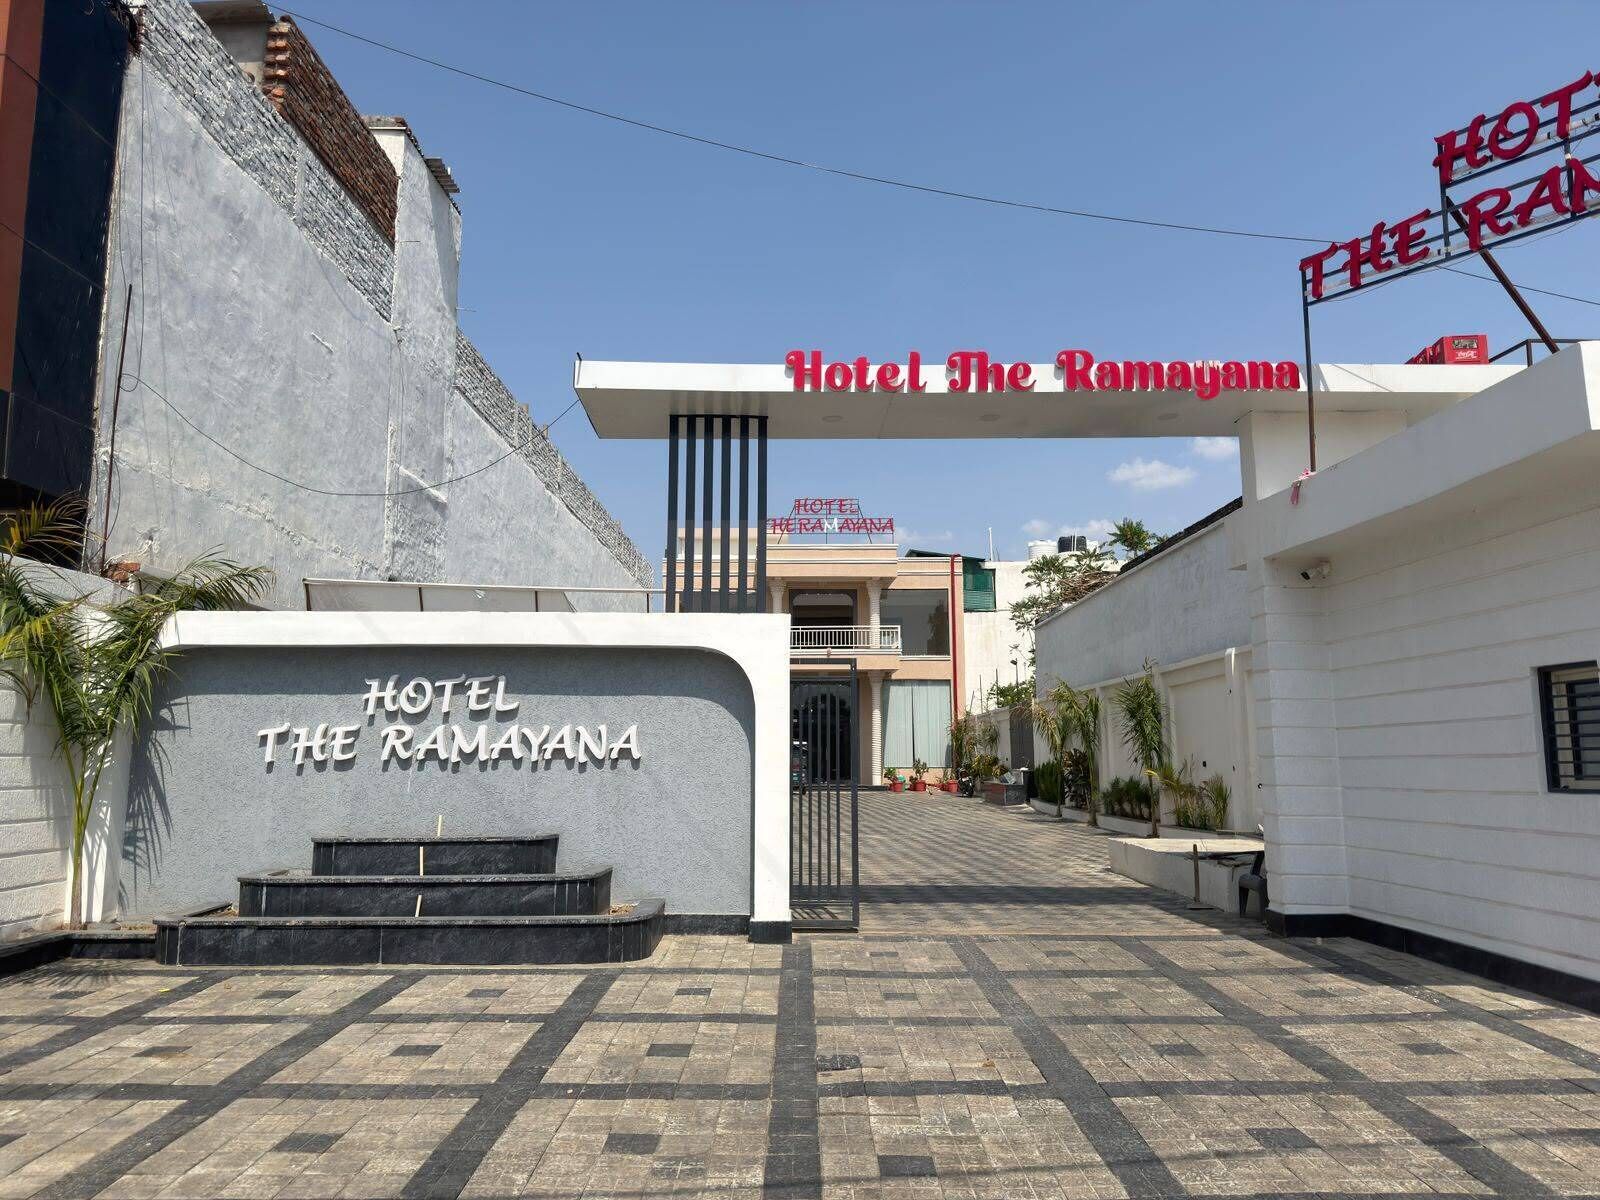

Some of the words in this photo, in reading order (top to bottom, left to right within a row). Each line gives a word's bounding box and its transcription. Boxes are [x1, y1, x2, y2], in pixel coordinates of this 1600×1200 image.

[1432, 70, 1600, 185] HOT
[1299, 208, 1431, 299] THE
[785, 350, 927, 391] Hotel
[947, 351, 1036, 391] The
[1056, 350, 1300, 400] Ramayana
[766, 517, 795, 534] HE
[799, 517, 894, 534] RAMAYANA
[795, 498, 859, 514] HOTEL
[363, 674, 519, 715] HOTEL
[257, 722, 357, 765] THE
[380, 724, 642, 763] RAMAYANA
